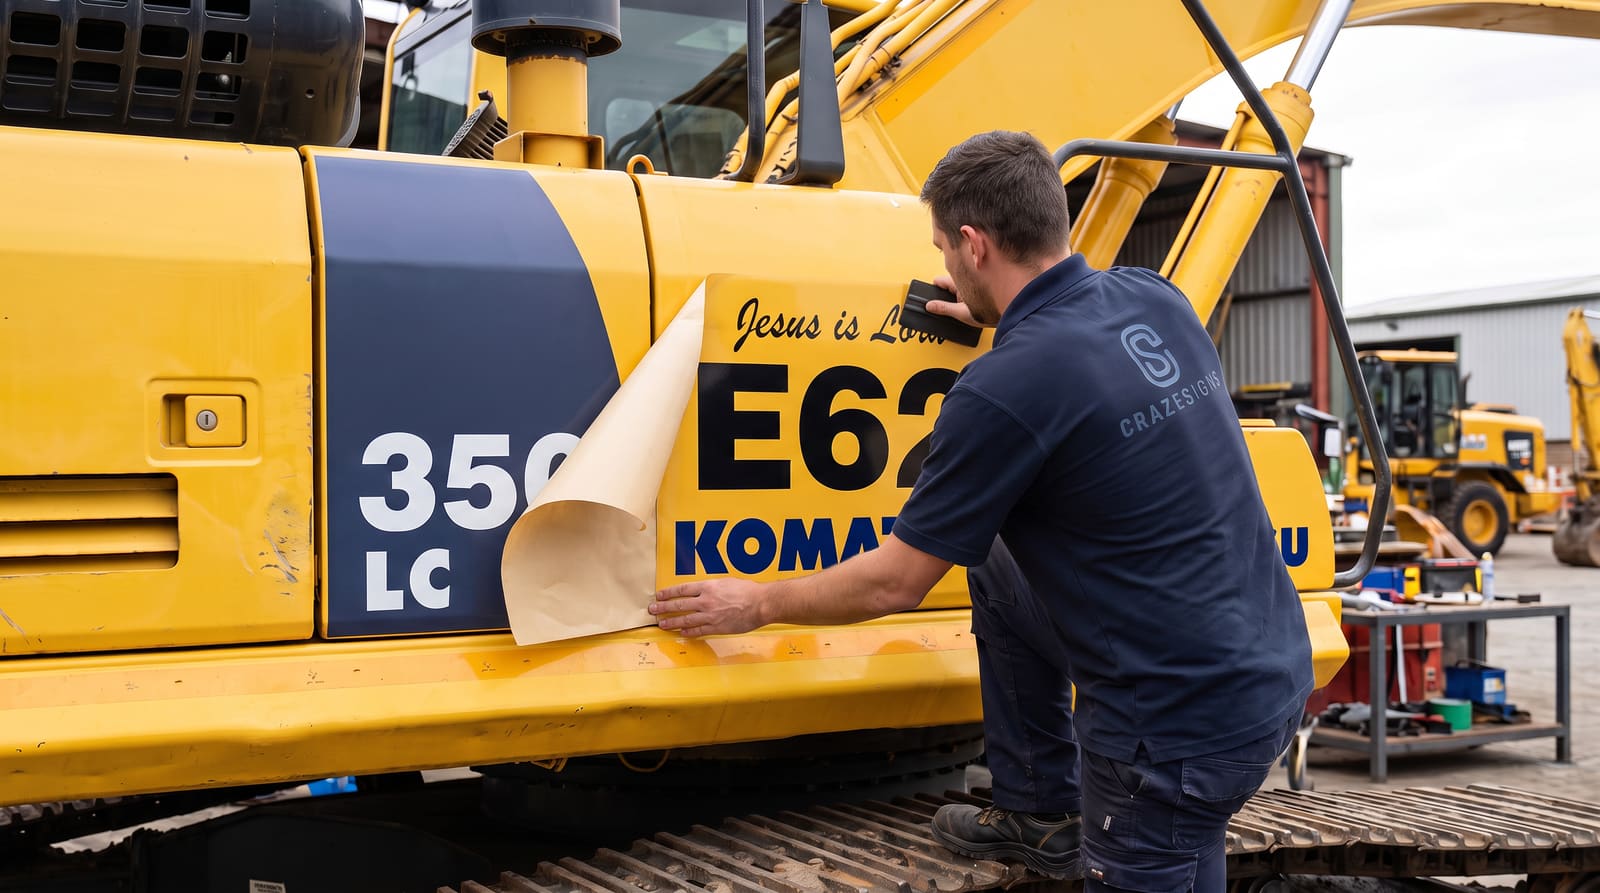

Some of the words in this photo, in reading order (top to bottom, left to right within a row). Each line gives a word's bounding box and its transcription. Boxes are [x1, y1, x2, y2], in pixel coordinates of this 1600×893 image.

[734, 297, 821, 352] Jesus
[834, 311, 859, 339] is
[1120, 371, 1220, 438] CRAZESIGNS
[1272, 526, 1309, 567] U
[366, 548, 451, 612] LC
